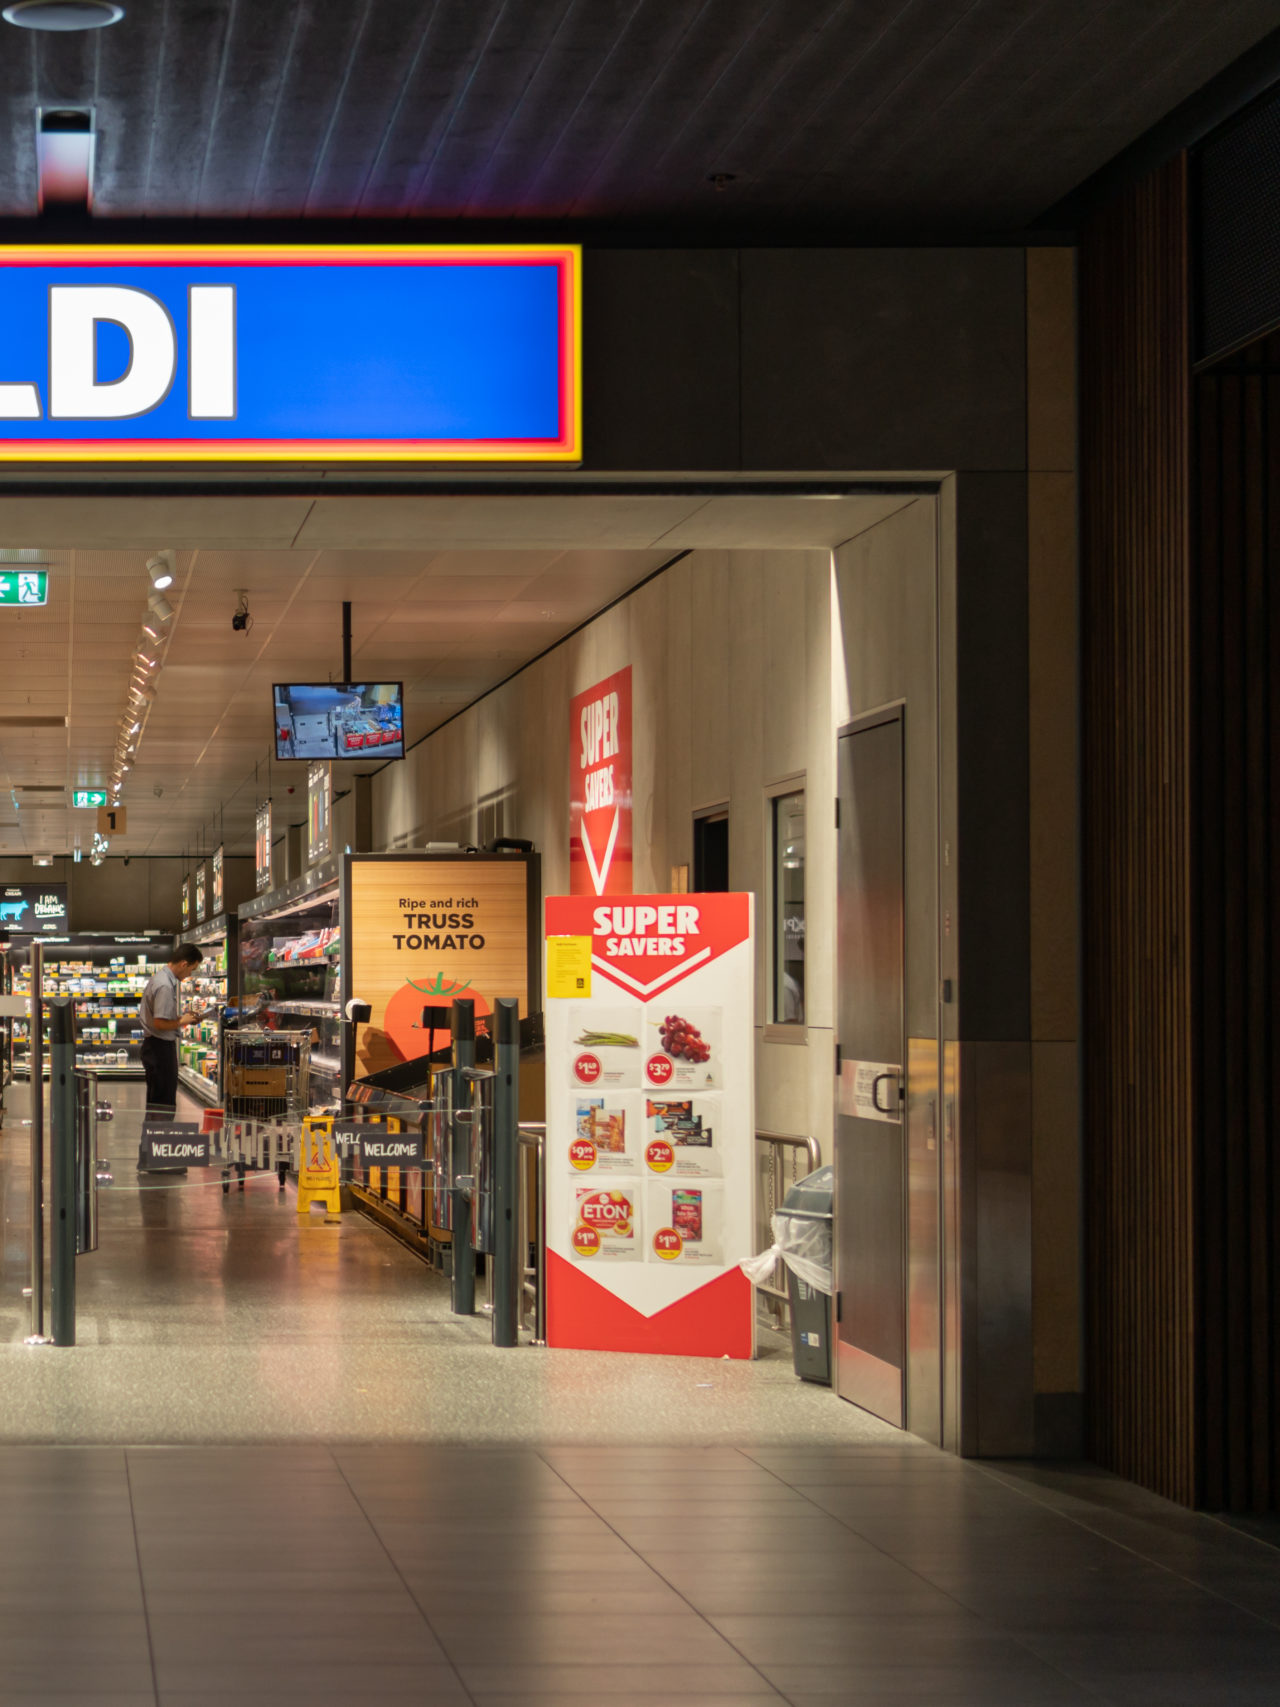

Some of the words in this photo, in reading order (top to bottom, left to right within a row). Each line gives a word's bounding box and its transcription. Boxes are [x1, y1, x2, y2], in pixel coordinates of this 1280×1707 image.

[581, 691, 619, 769] SUPER
[585, 764, 614, 814] SAVERS
[107, 812, 116, 830] 1
[398, 898, 426, 911] Ripe
[430, 898, 452, 908] and
[456, 898, 478, 908] rich
[404, 914, 474, 929] TRUSS
[593, 906, 700, 936] SUPER
[392, 934, 485, 950] TOMATO
[606, 937, 686, 956] SAVERS
[335, 1131, 360, 1146] WELC
[152, 1142, 205, 1157] WELCOME
[364, 1142, 417, 1157] WELCOME
[583, 1204, 629, 1219] ETON
